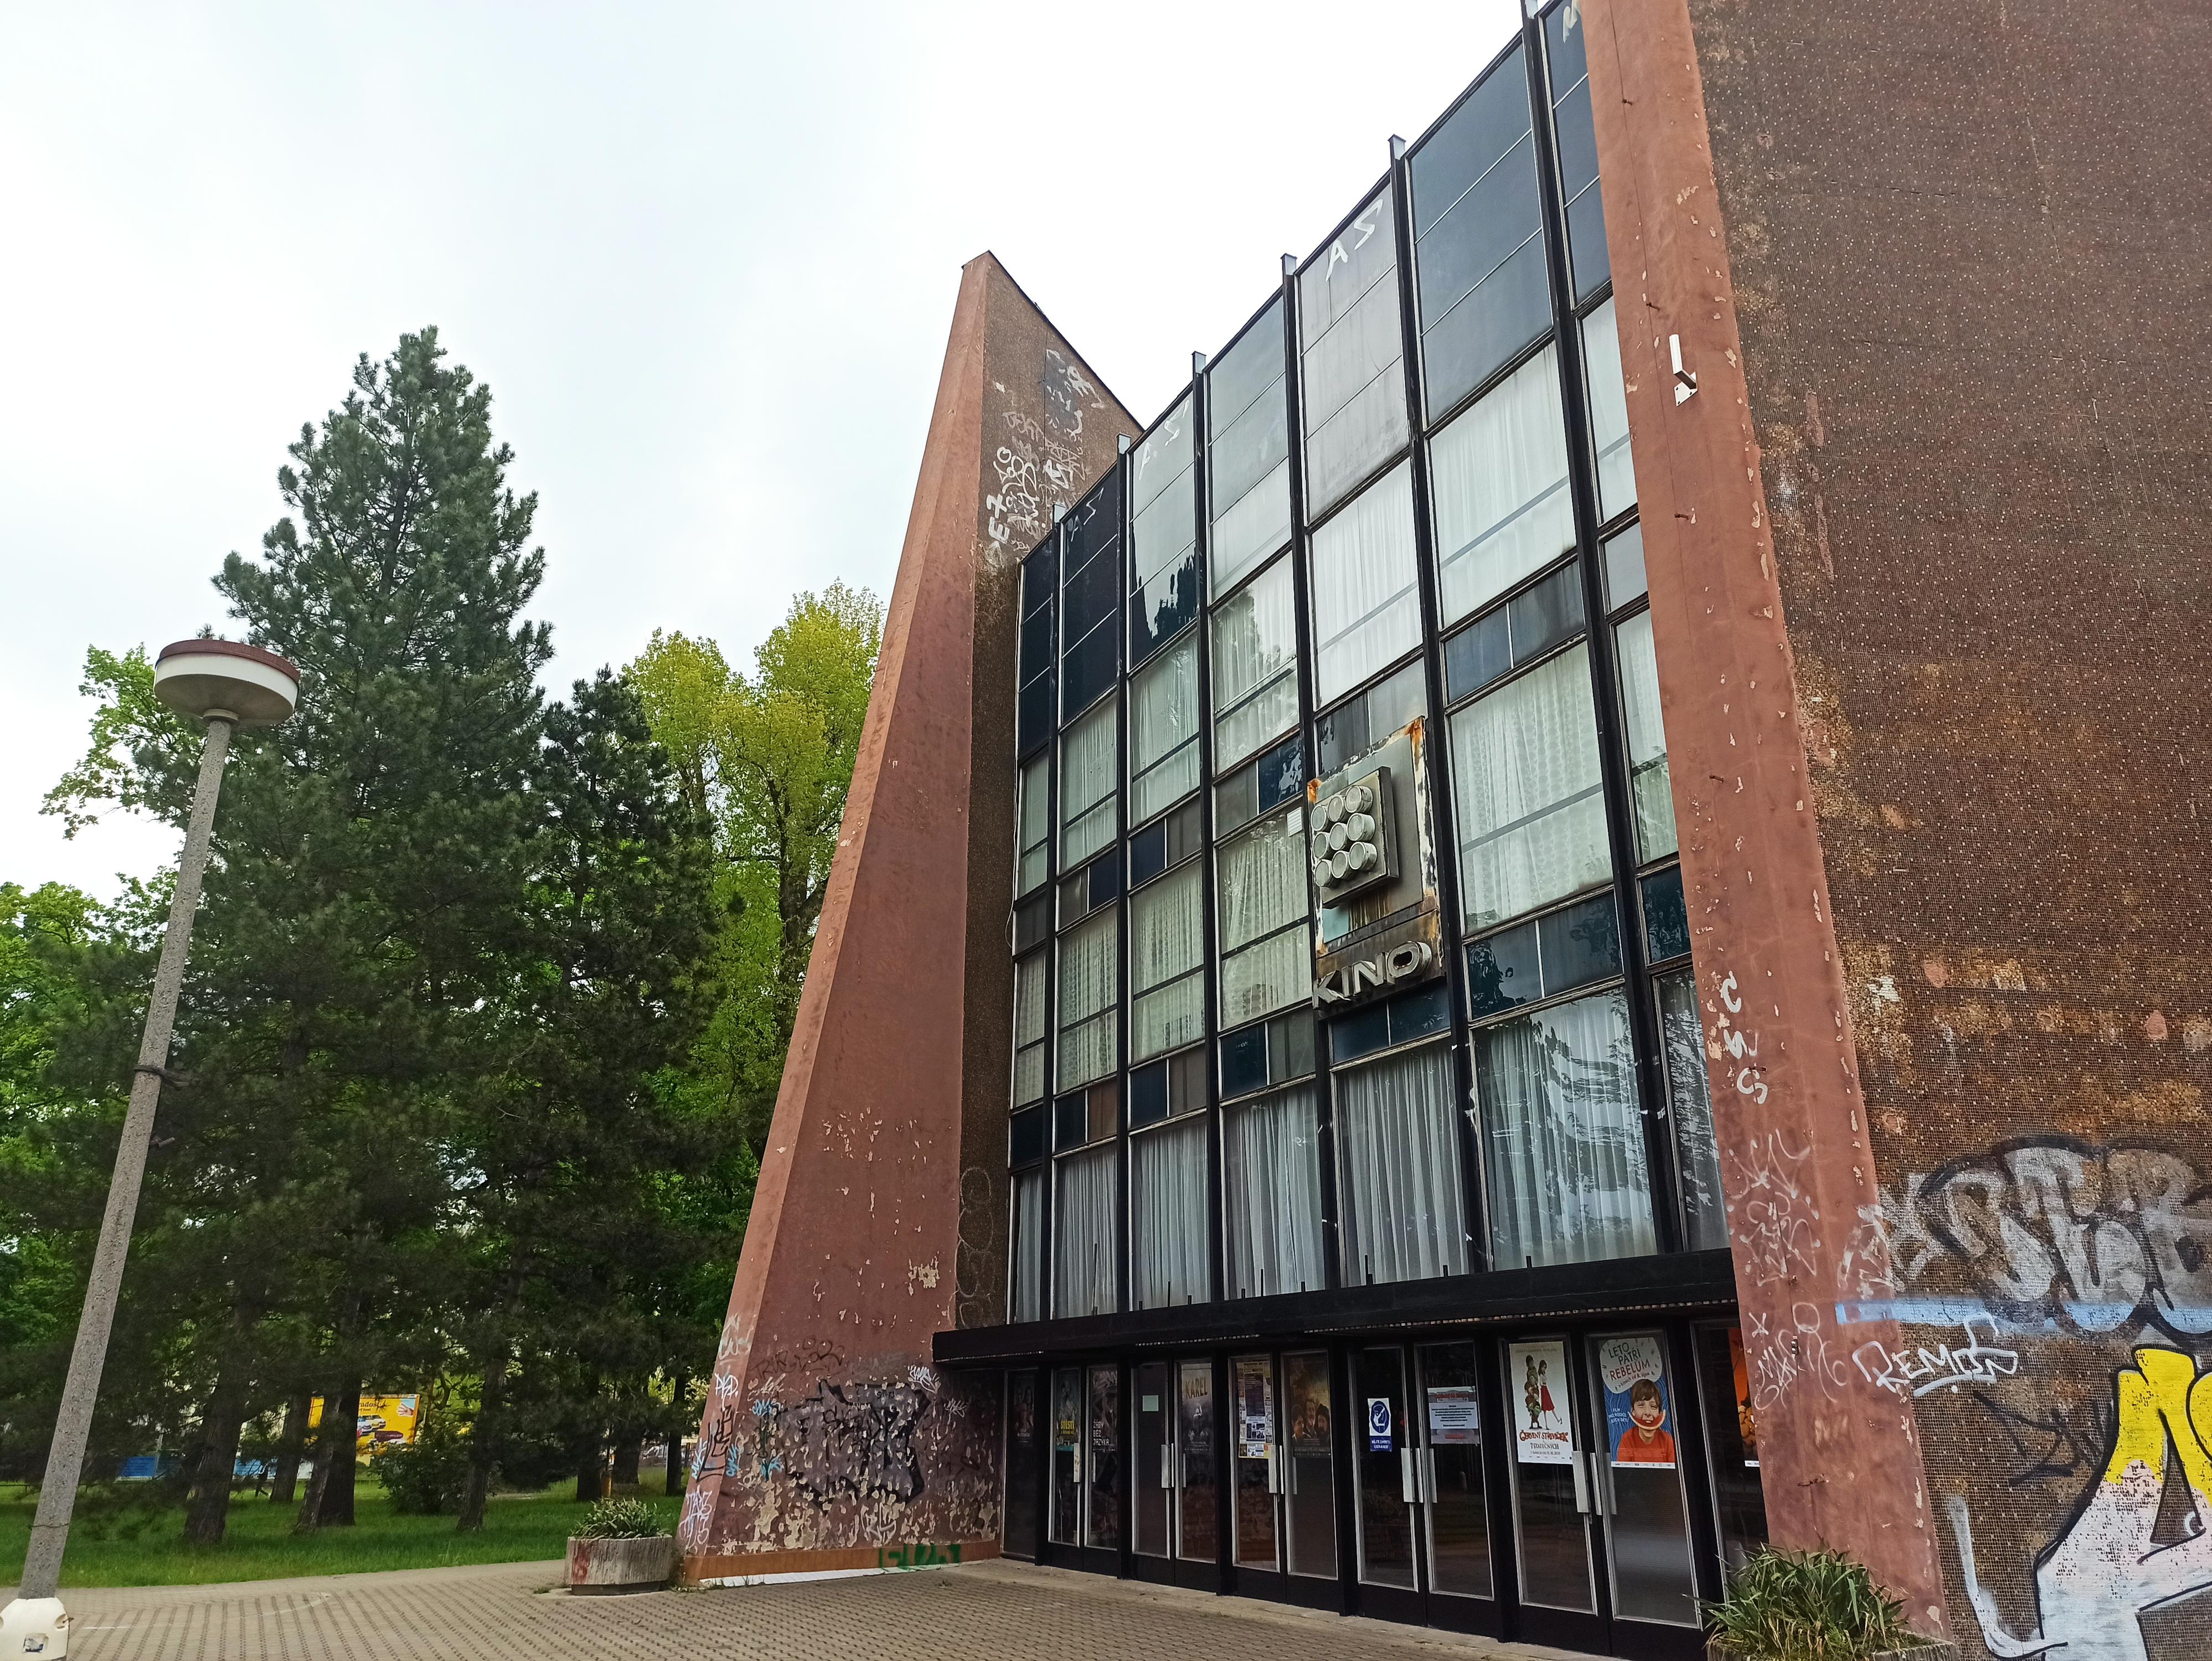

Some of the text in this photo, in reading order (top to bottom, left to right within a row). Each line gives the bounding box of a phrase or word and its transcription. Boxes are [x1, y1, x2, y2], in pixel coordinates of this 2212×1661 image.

[1312, 941, 1432, 1009] KINO
[1185, 1376, 1208, 1399] KAREL
[1093, 1418, 1104, 1428] ŽÁBY
